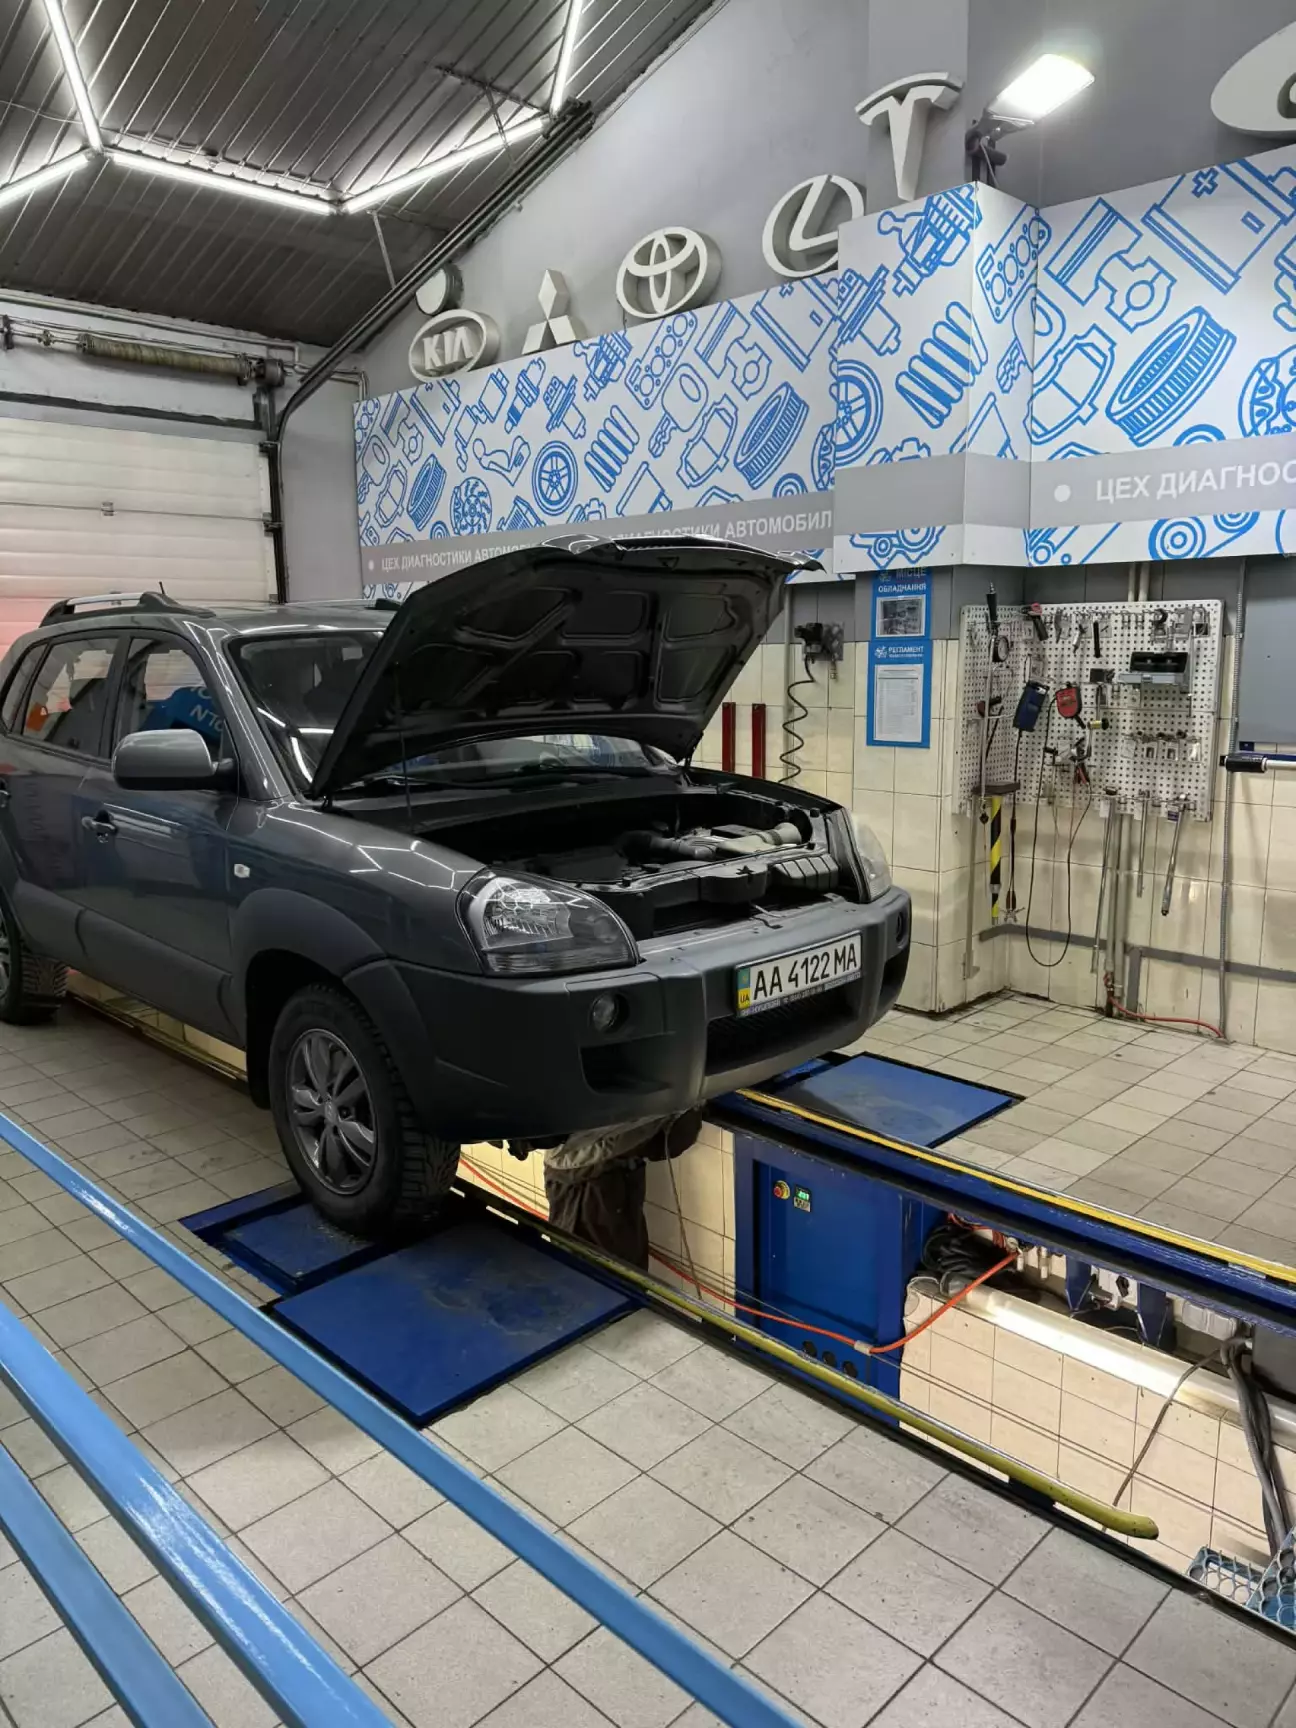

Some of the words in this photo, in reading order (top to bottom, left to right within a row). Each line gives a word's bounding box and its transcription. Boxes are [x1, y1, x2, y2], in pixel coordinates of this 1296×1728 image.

[422, 326, 475, 371] KIA
[1096, 475, 1151, 503] ЦЕХ
[725, 510, 832, 538] АВТОМОБИЛ
[382, 556, 400, 572] ЦЕХ
[401, 549, 471, 571] ДИАГНОСТИКИ
[753, 966, 783, 1000] AA
[788, 952, 830, 989] 4122
[834, 943, 857, 975] MA
[740, 993, 750, 1003] UA
